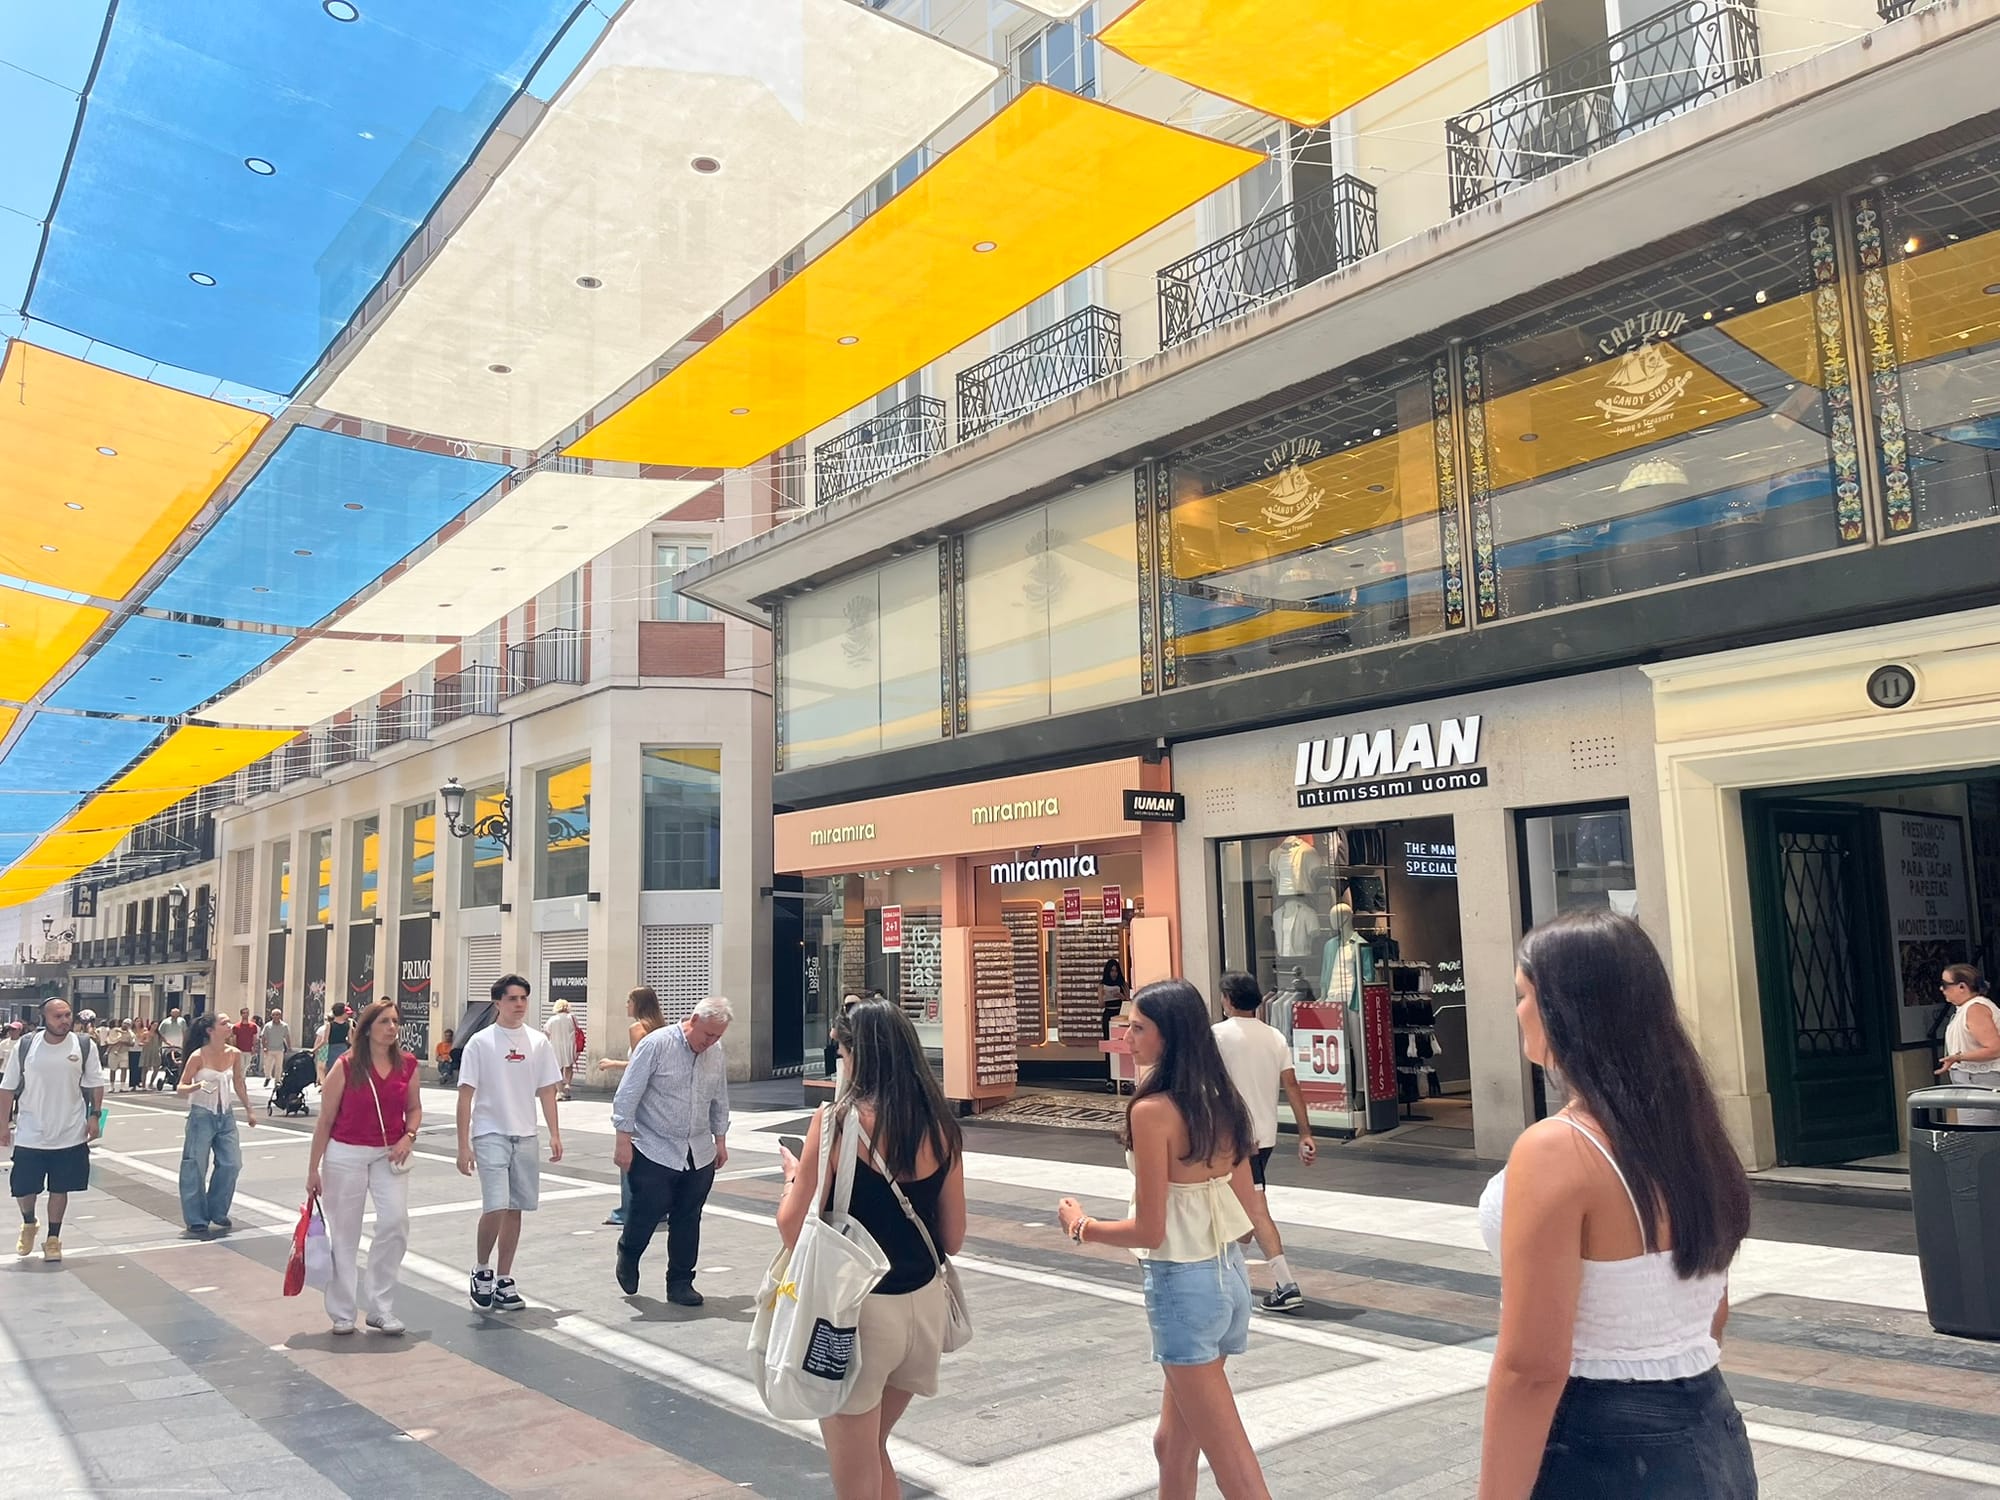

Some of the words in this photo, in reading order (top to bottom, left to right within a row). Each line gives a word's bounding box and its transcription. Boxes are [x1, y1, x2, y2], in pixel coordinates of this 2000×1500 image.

[1598, 310, 1686, 355] CAPTAIN
[1613, 394, 1645, 406] CANDY
[1649, 377, 1676, 401] SHOP
[1264, 438, 1321, 471] CAPTAIN
[1273, 504, 1294, 514] CANDY
[1296, 493, 1314, 511] SHOP
[1881, 678, 1902, 699] 11
[1295, 715, 1482, 787] IUMAN
[1300, 777, 1413, 806] intimissimi
[1422, 772, 1482, 792] uomo
[971, 796, 1059, 825] miramira
[1133, 796, 1175, 811] IUMAN
[810, 823, 876, 846] miramira
[1404, 842, 1427, 855] THE
[1431, 843, 1456, 856] MAN
[991, 854, 1096, 884] miramira
[1901, 859, 1923, 878] PARA
[1067, 900, 1077, 908] 2+1
[1106, 898, 1117, 906] 2+1
[885, 921, 898, 932] 2+1
[912, 926, 927, 944] re
[1898, 918, 1927, 936] MONTE
[914, 944, 934, 967] ba
[1375, 996, 1385, 1090] REBAJAS
